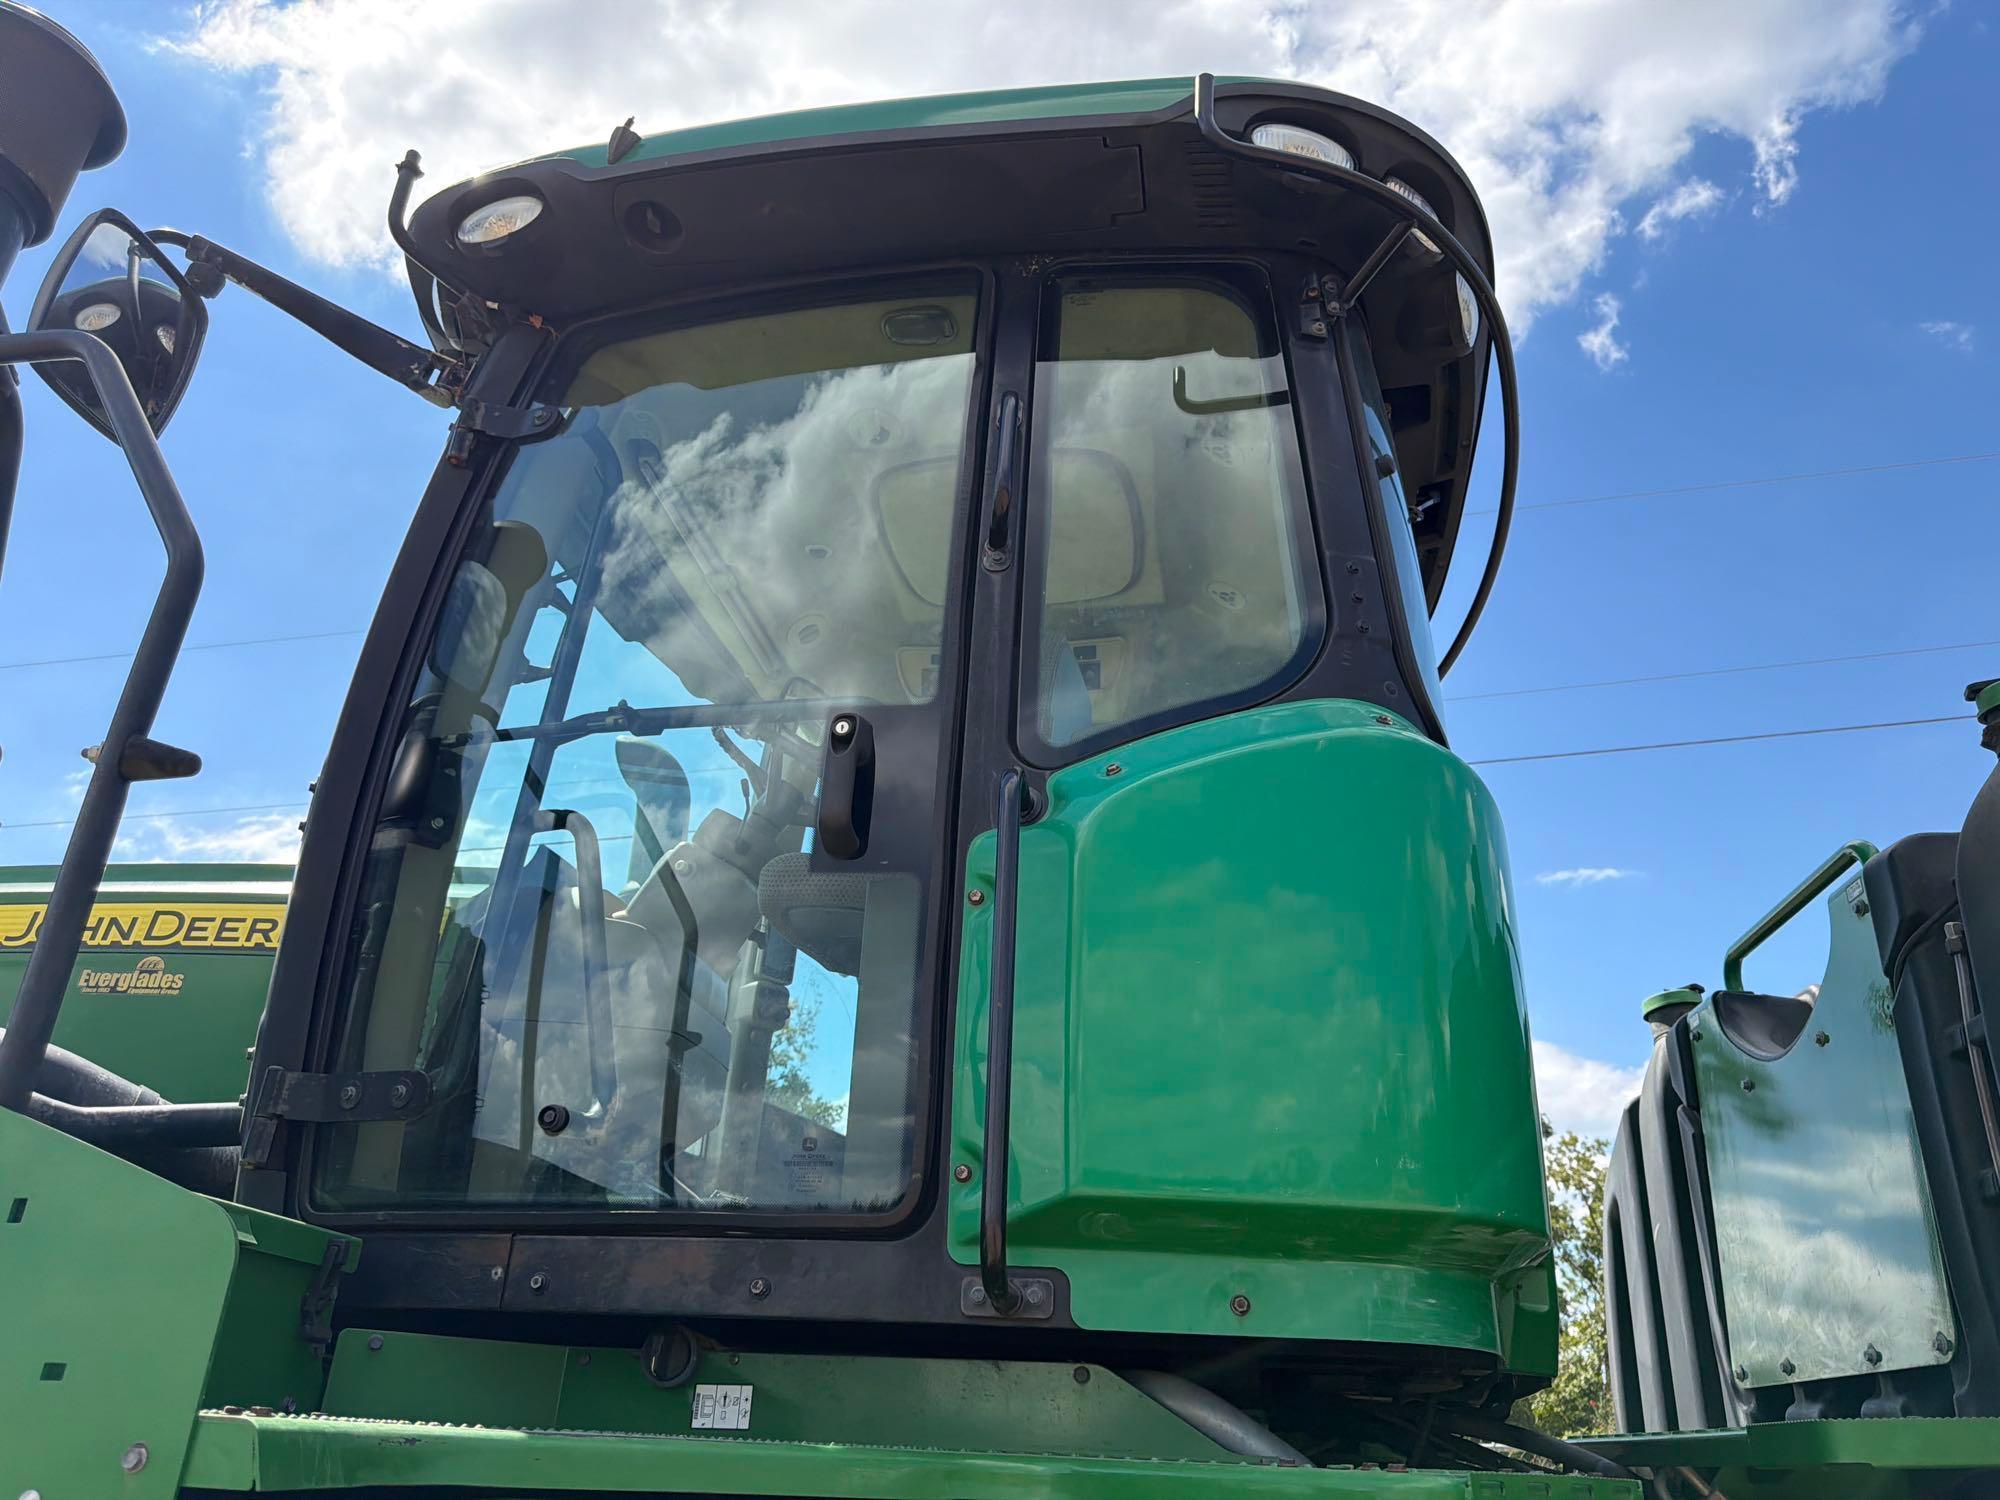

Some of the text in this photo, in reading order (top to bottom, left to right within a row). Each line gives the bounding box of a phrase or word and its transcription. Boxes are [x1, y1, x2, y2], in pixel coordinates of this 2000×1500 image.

[3, 910, 280, 942] JHN DEER
[78, 969, 185, 991] Everglades
